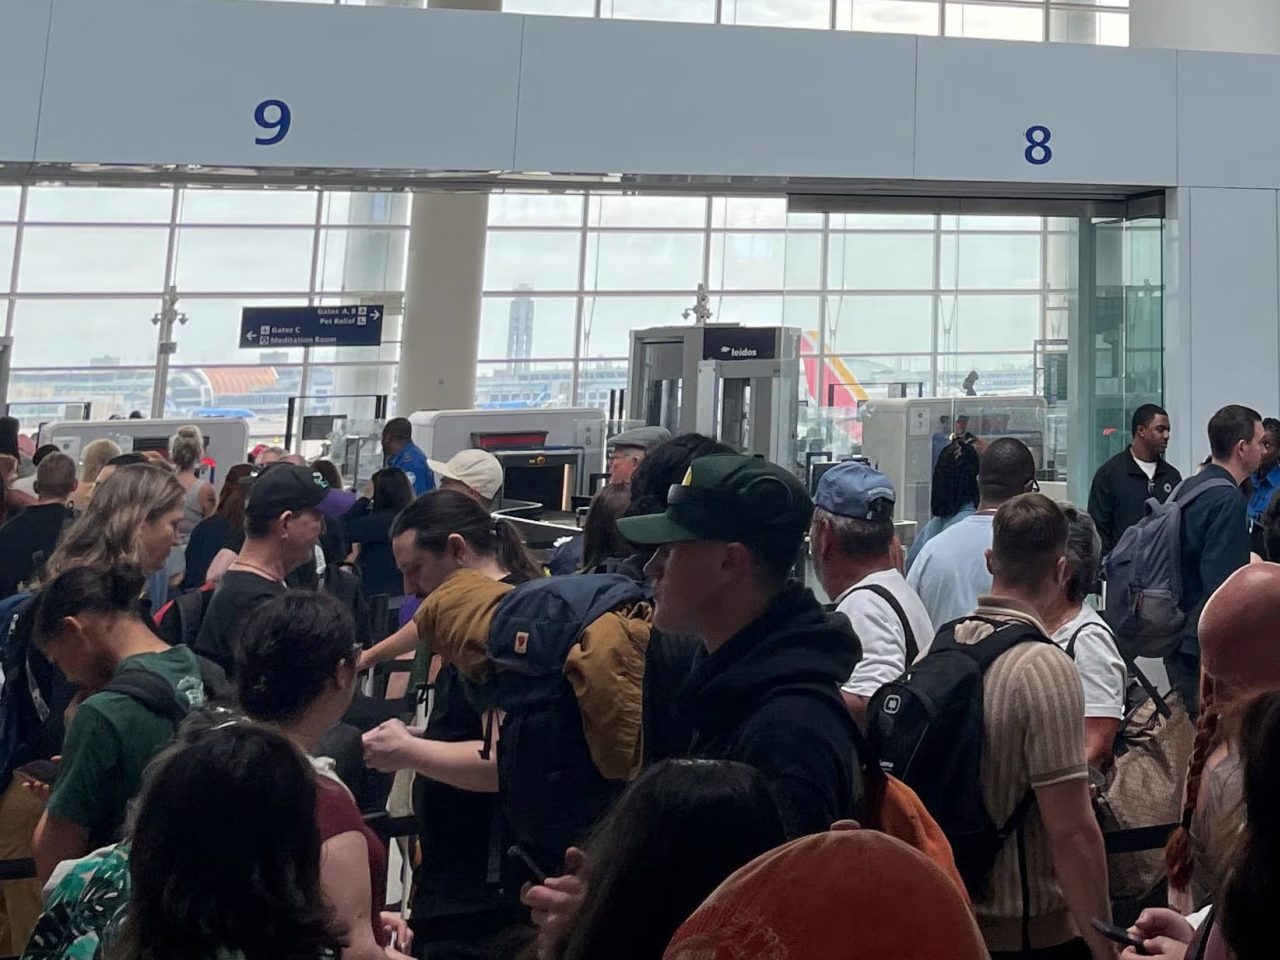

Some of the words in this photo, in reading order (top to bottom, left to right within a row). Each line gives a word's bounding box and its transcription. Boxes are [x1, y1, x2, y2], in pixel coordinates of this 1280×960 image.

[255, 100, 290, 145] 9
[1024, 126, 1052, 165] 8
[334, 317, 356, 325] Relief
[270, 336, 314, 344] Meditation
[731, 348, 757, 356] leidos
